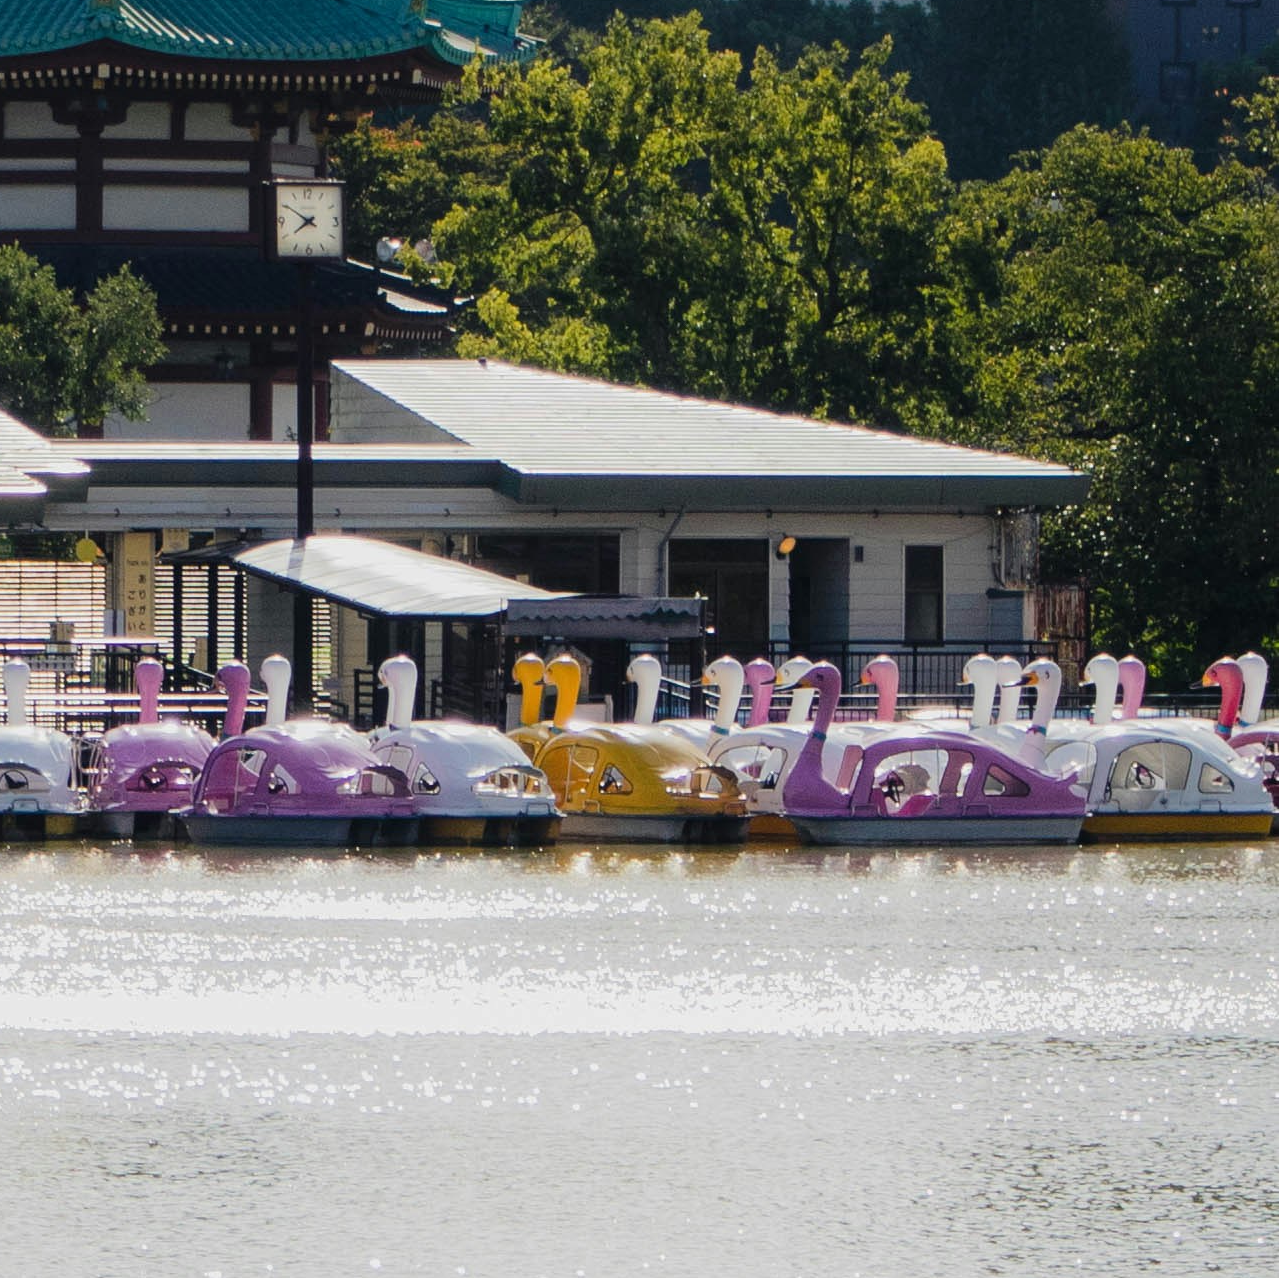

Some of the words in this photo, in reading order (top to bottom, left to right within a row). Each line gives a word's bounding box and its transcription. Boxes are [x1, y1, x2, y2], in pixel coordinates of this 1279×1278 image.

[303, 188, 312, 200] 12
[278, 216, 285, 228] 9
[332, 216, 339, 228] 3
[305, 244, 313, 256] 6
